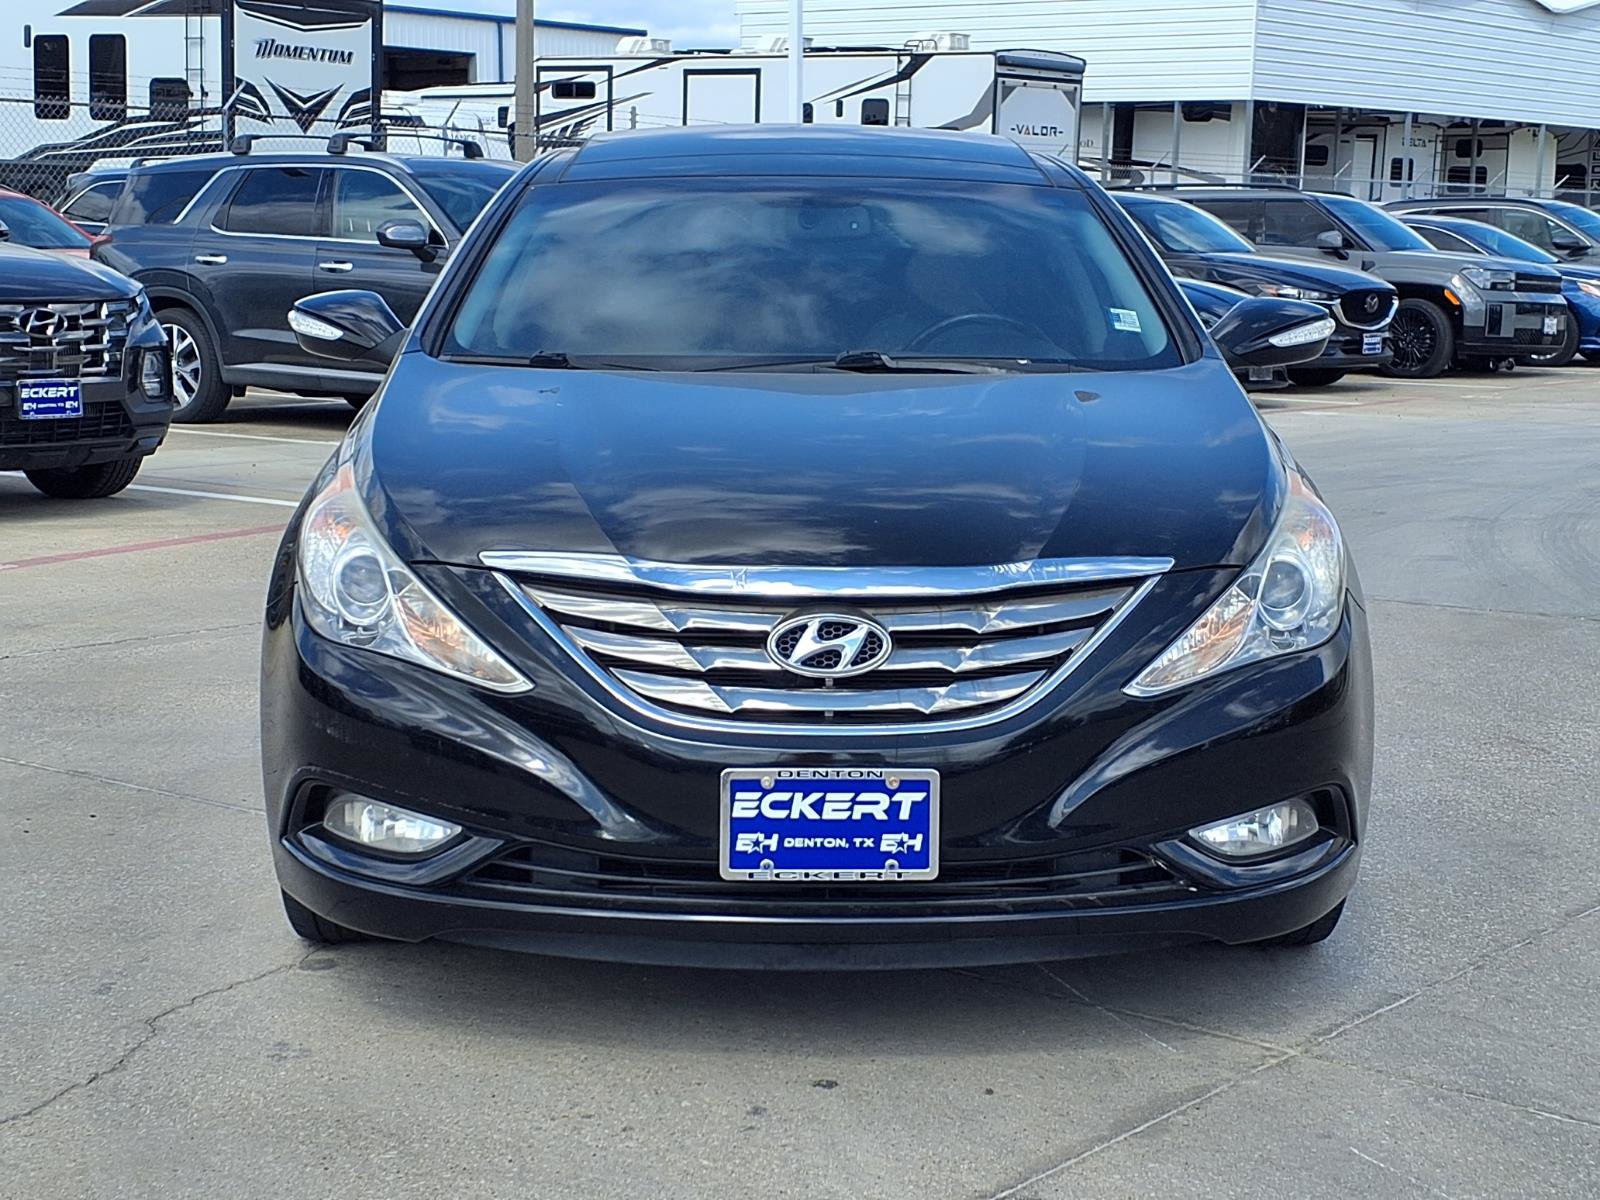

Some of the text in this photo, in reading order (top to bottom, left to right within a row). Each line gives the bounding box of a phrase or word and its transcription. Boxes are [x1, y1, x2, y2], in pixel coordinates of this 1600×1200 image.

[255, 38, 354, 65] MOMENTUM
[21, 387, 78, 398] ECKERT
[777, 770, 884, 779] DENTON
[732, 791, 928, 821] ECKERT
[783, 837, 849, 849] DENTON,
[853, 837, 875, 848] TX
[748, 871, 910, 880] ECKERT
